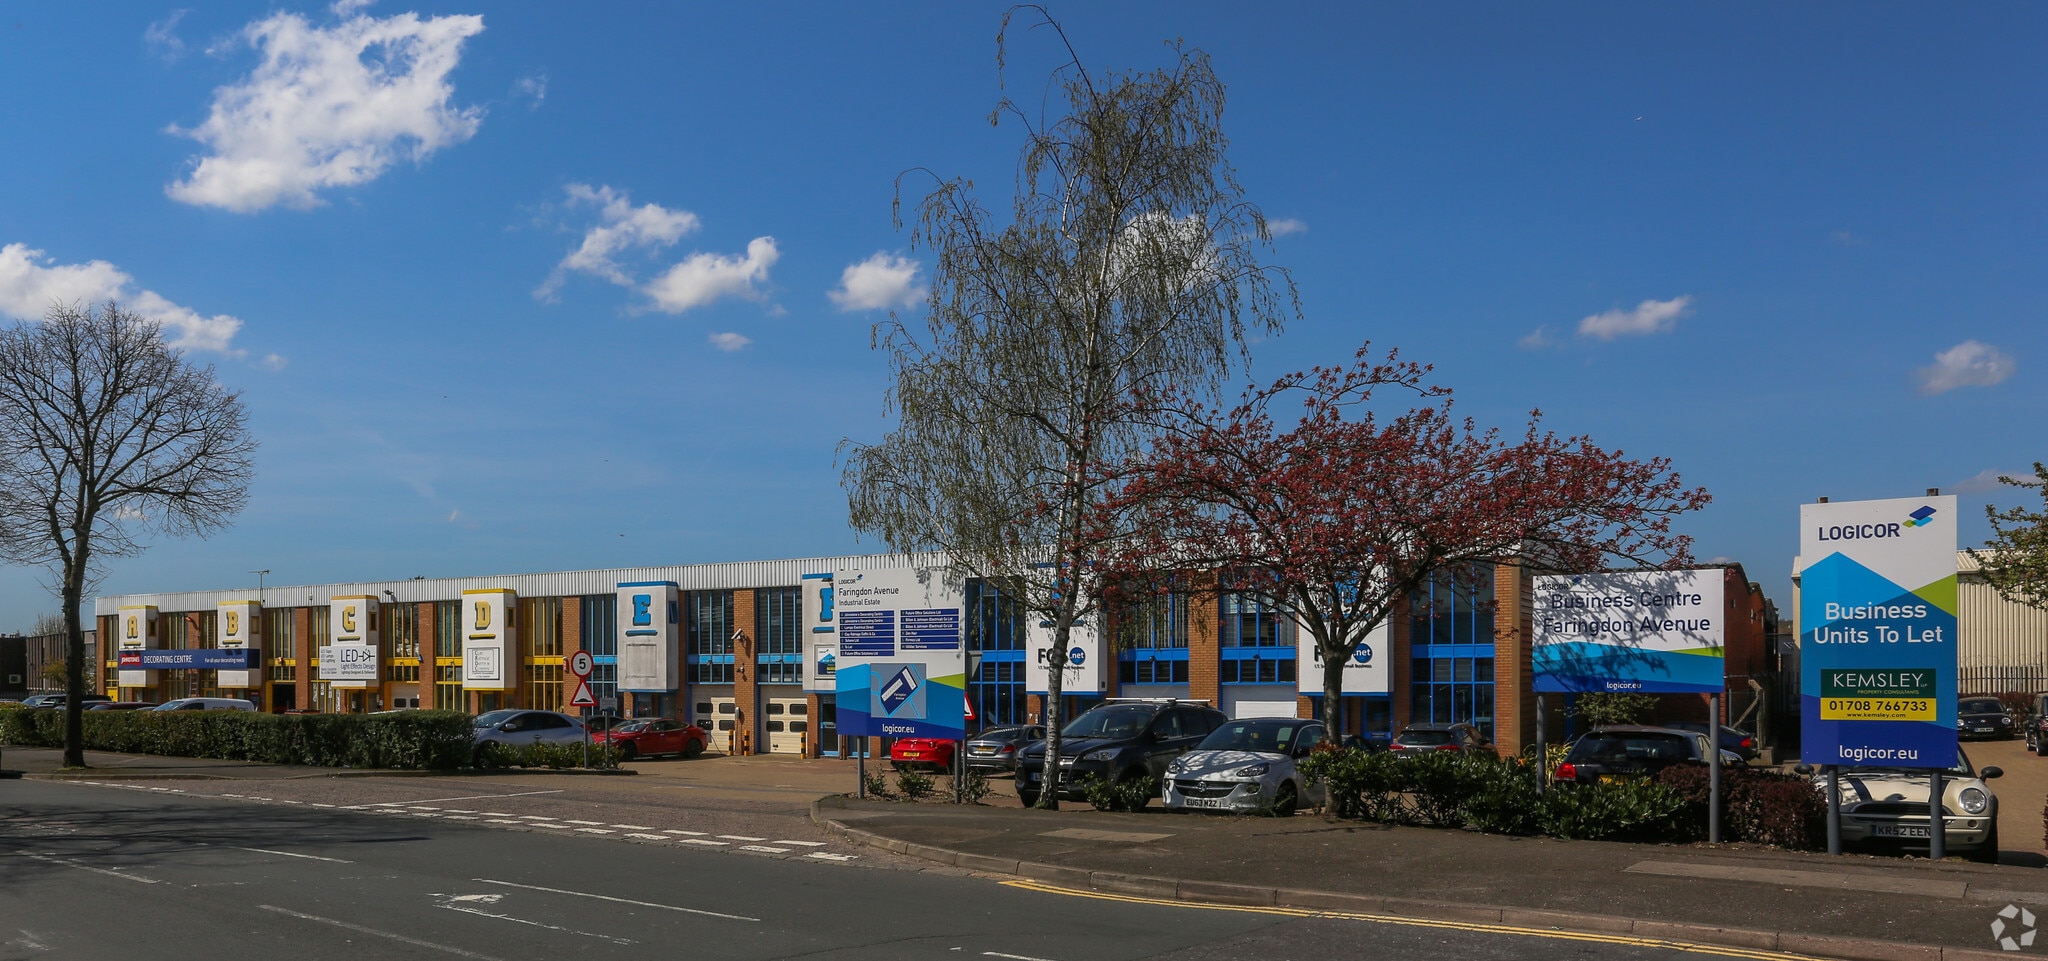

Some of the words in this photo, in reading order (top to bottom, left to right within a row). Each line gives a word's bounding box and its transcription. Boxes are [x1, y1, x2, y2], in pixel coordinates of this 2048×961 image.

[1819, 524, 1900, 541] LOGICOR
[839, 587, 872, 597] Faringdon
[1552, 593, 1633, 608] Business
[1640, 591, 1701, 607] Centre
[475, 600, 491, 630] D
[633, 594, 651, 626] E
[1825, 602, 1927, 620] Business
[127, 615, 138, 638] A
[226, 610, 238, 636] B
[342, 606, 355, 632] C
[1544, 617, 1633, 636] Faringdon
[1640, 616, 1710, 632] Avenue
[1814, 626, 1869, 644] Units
[1875, 626, 1899, 643] To
[1908, 625, 1943, 643] Let
[143, 655, 173, 664] DECORATING
[174, 655, 192, 663] CENTRE
[341, 649, 358, 662] LED
[579, 658, 586, 669] 5
[1606, 681, 1642, 690] logicor.eu
[1833, 673, 1923, 687] KEMSLEY
[1830, 701, 1870, 710] 01708
[1876, 701, 1927, 711] 766733
[882, 724, 914, 734] logicor.eu
[1840, 745, 1918, 761] logicor.eu
[1186, 799, 1203, 807] EU63
[1878, 827, 1906, 836] KR52
[1910, 828, 1930, 836] EEN
